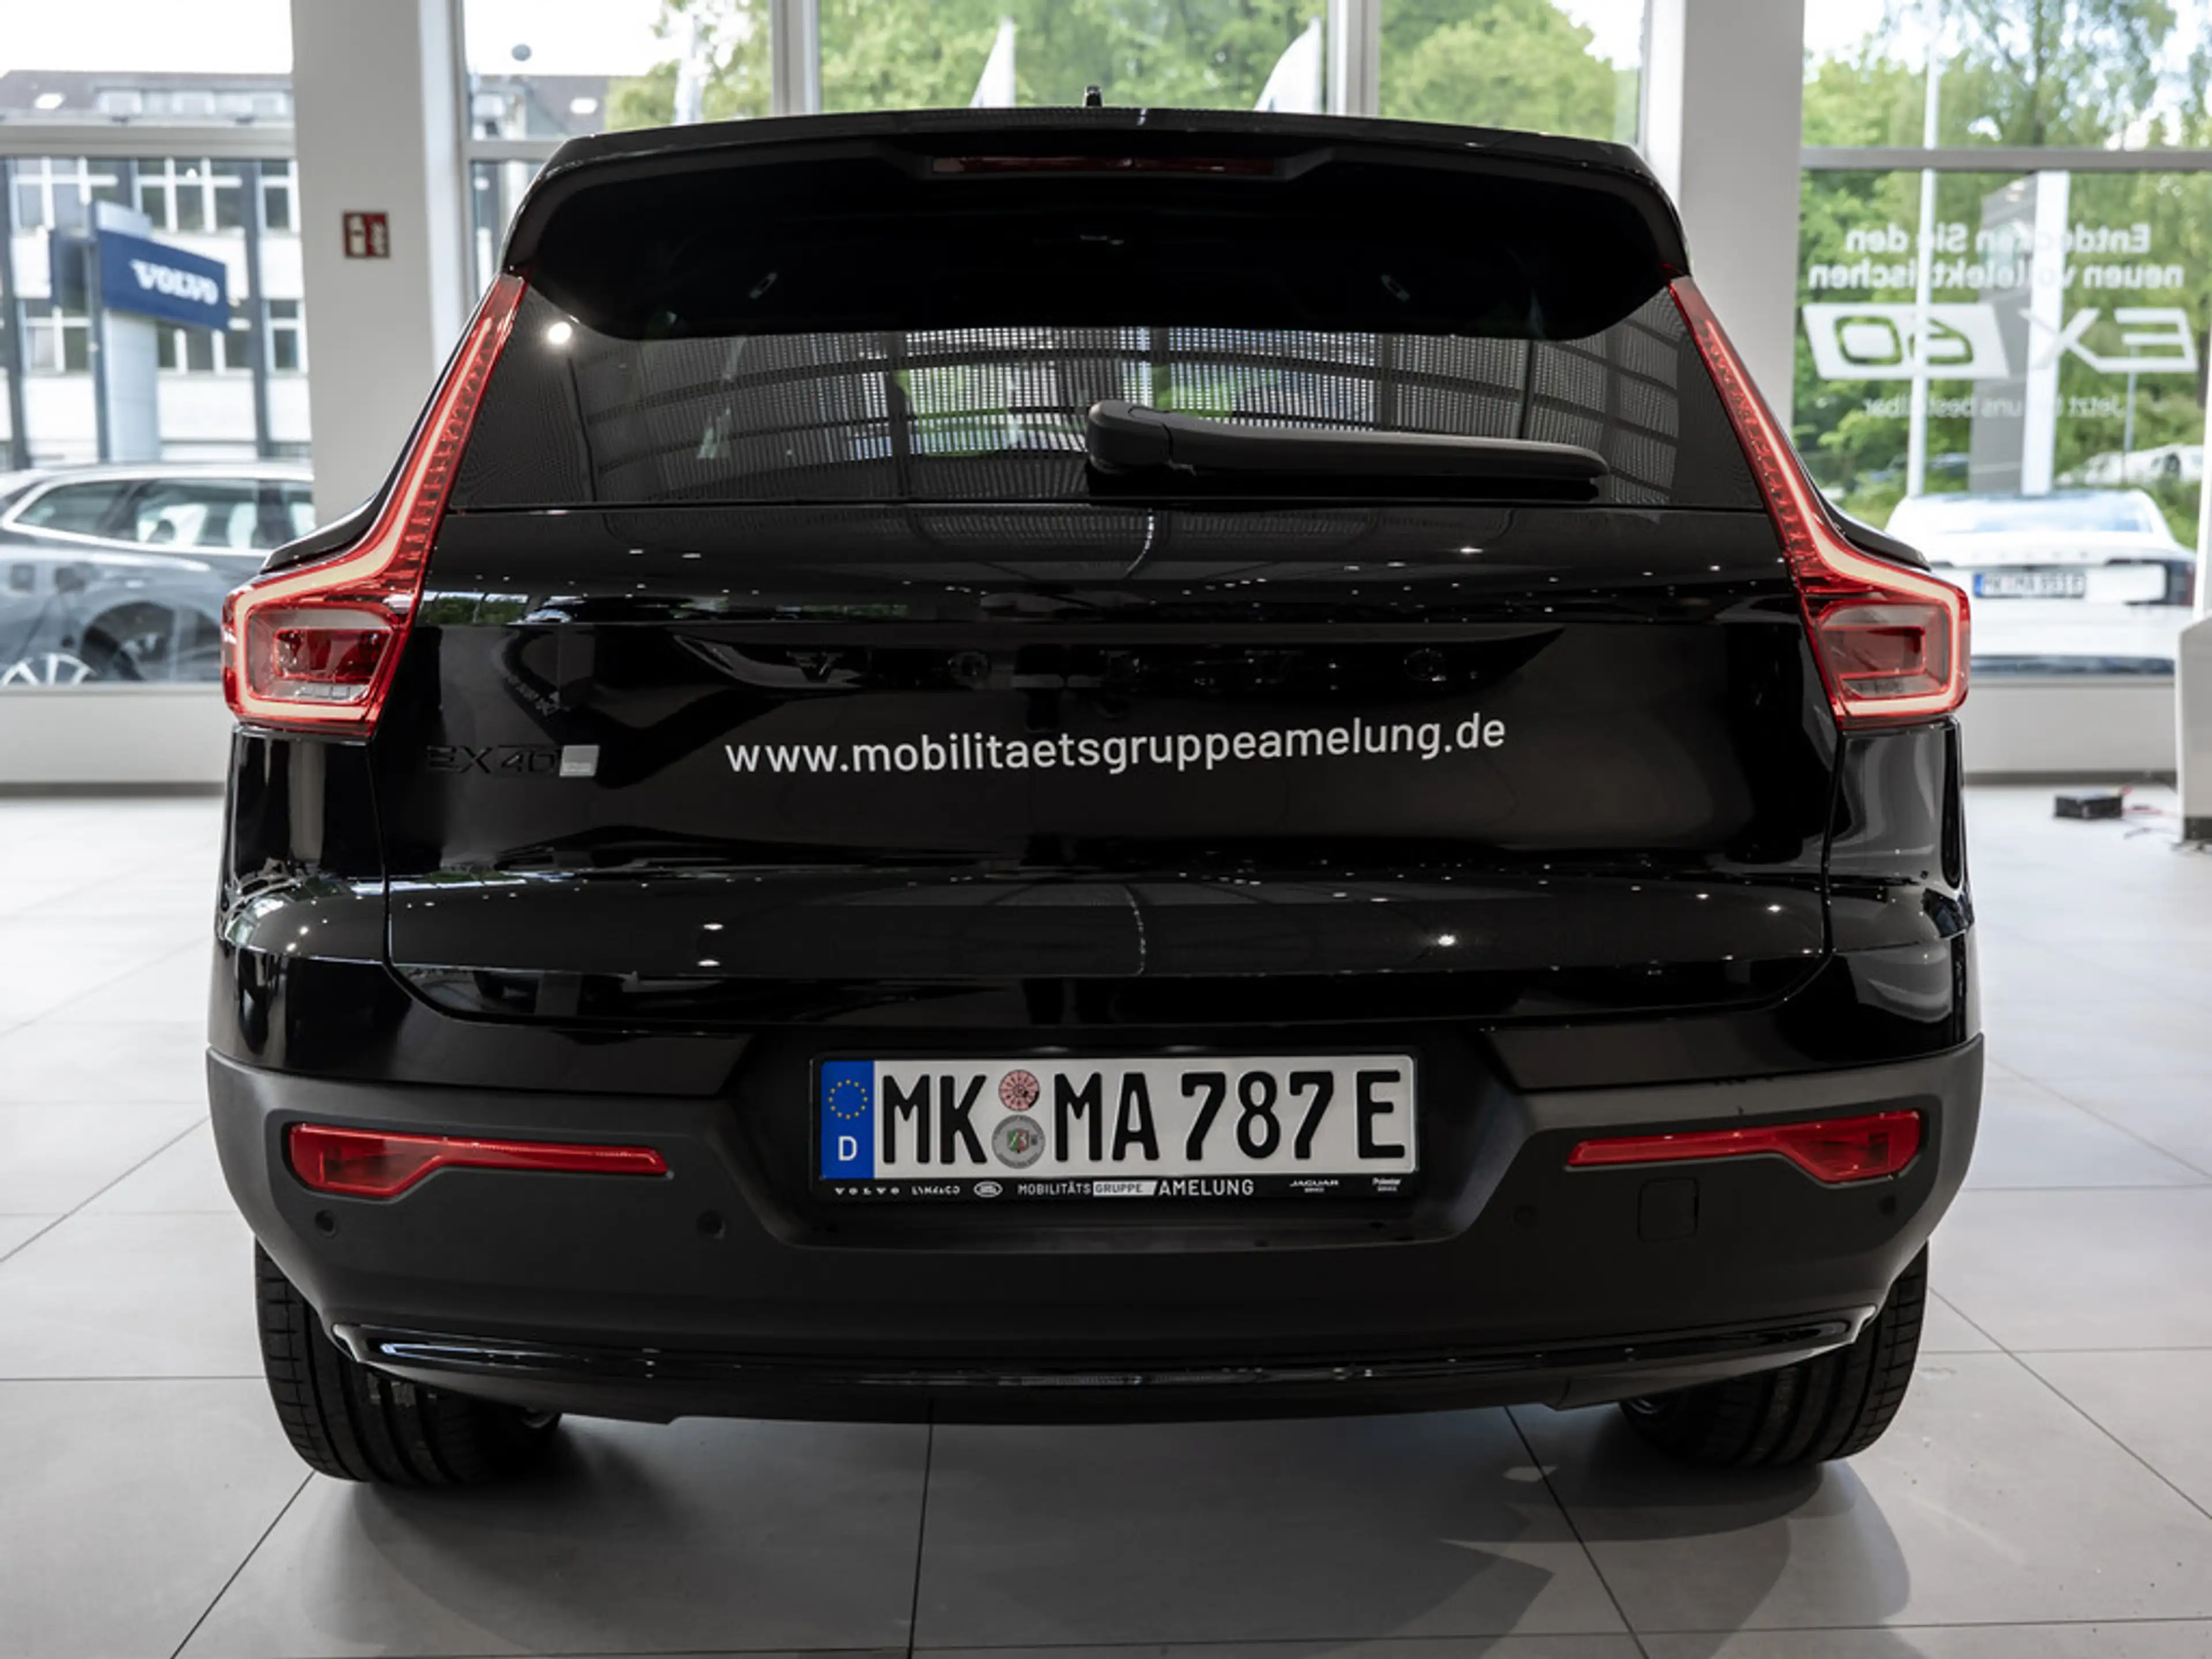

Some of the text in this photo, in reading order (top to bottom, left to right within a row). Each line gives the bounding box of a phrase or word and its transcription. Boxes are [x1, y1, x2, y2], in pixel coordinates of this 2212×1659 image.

[130, 259, 218, 305] VOLVO
[725, 712, 1505, 775] www.mobilitaetsgruppeamelung.de
[882, 1074, 988, 1165] MK
[1054, 1072, 1160, 1162] MA
[838, 1135, 857, 1161] D
[835, 1187, 900, 1195] VOLVO
[1018, 1181, 1090, 1195] MOBILITÄTS
[1095, 1183, 1143, 1194] GRUPPE
[1158, 1179, 1254, 1196] AMELUNG
